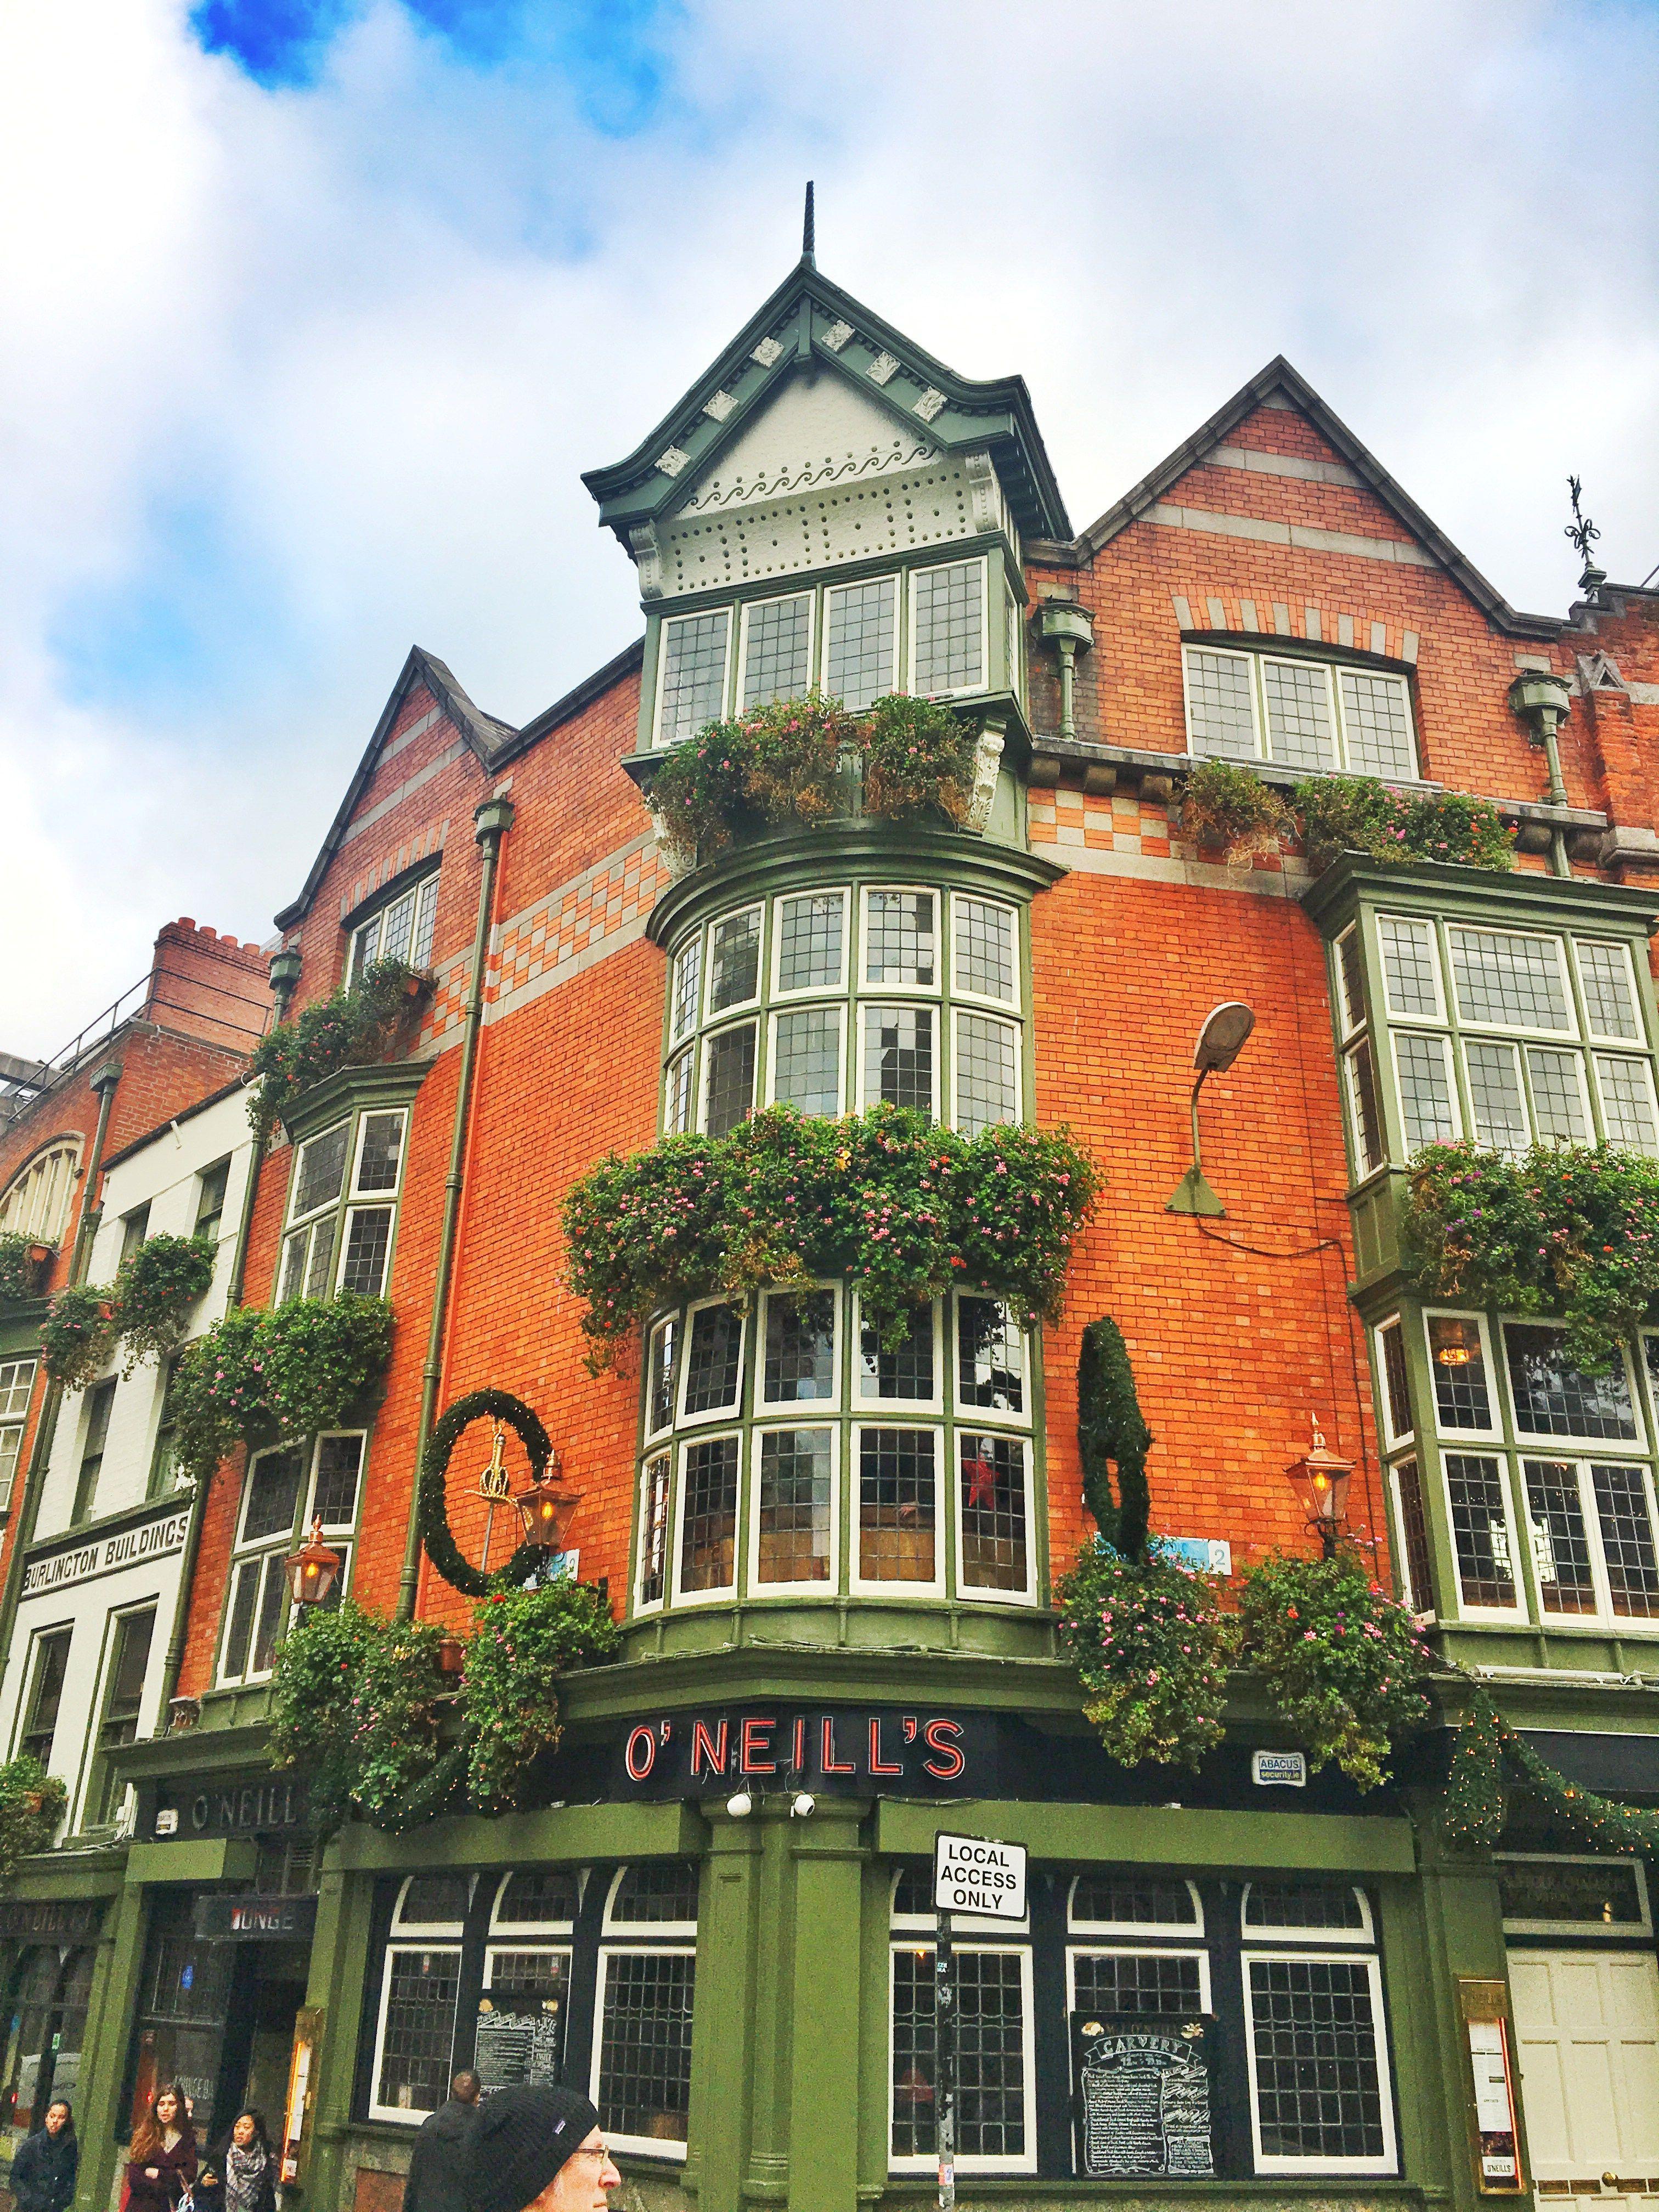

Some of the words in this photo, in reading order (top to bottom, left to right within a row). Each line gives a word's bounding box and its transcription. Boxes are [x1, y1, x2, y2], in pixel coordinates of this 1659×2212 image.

[24, 1548, 99, 1590] BURLINGTON
[105, 1515, 188, 1565] BUILDINGS
[1214, 1549, 1226, 1565] 2
[625, 1716, 966, 1781] O'NEILL'S
[1261, 1759, 1299, 1769] ABACUS
[949, 1844, 1009, 1867] LOCAL
[940, 1865, 1017, 1889] ACCESS
[953, 1889, 1003, 1909] ONLY
[1103, 2036, 1183, 2054] CARVERY
